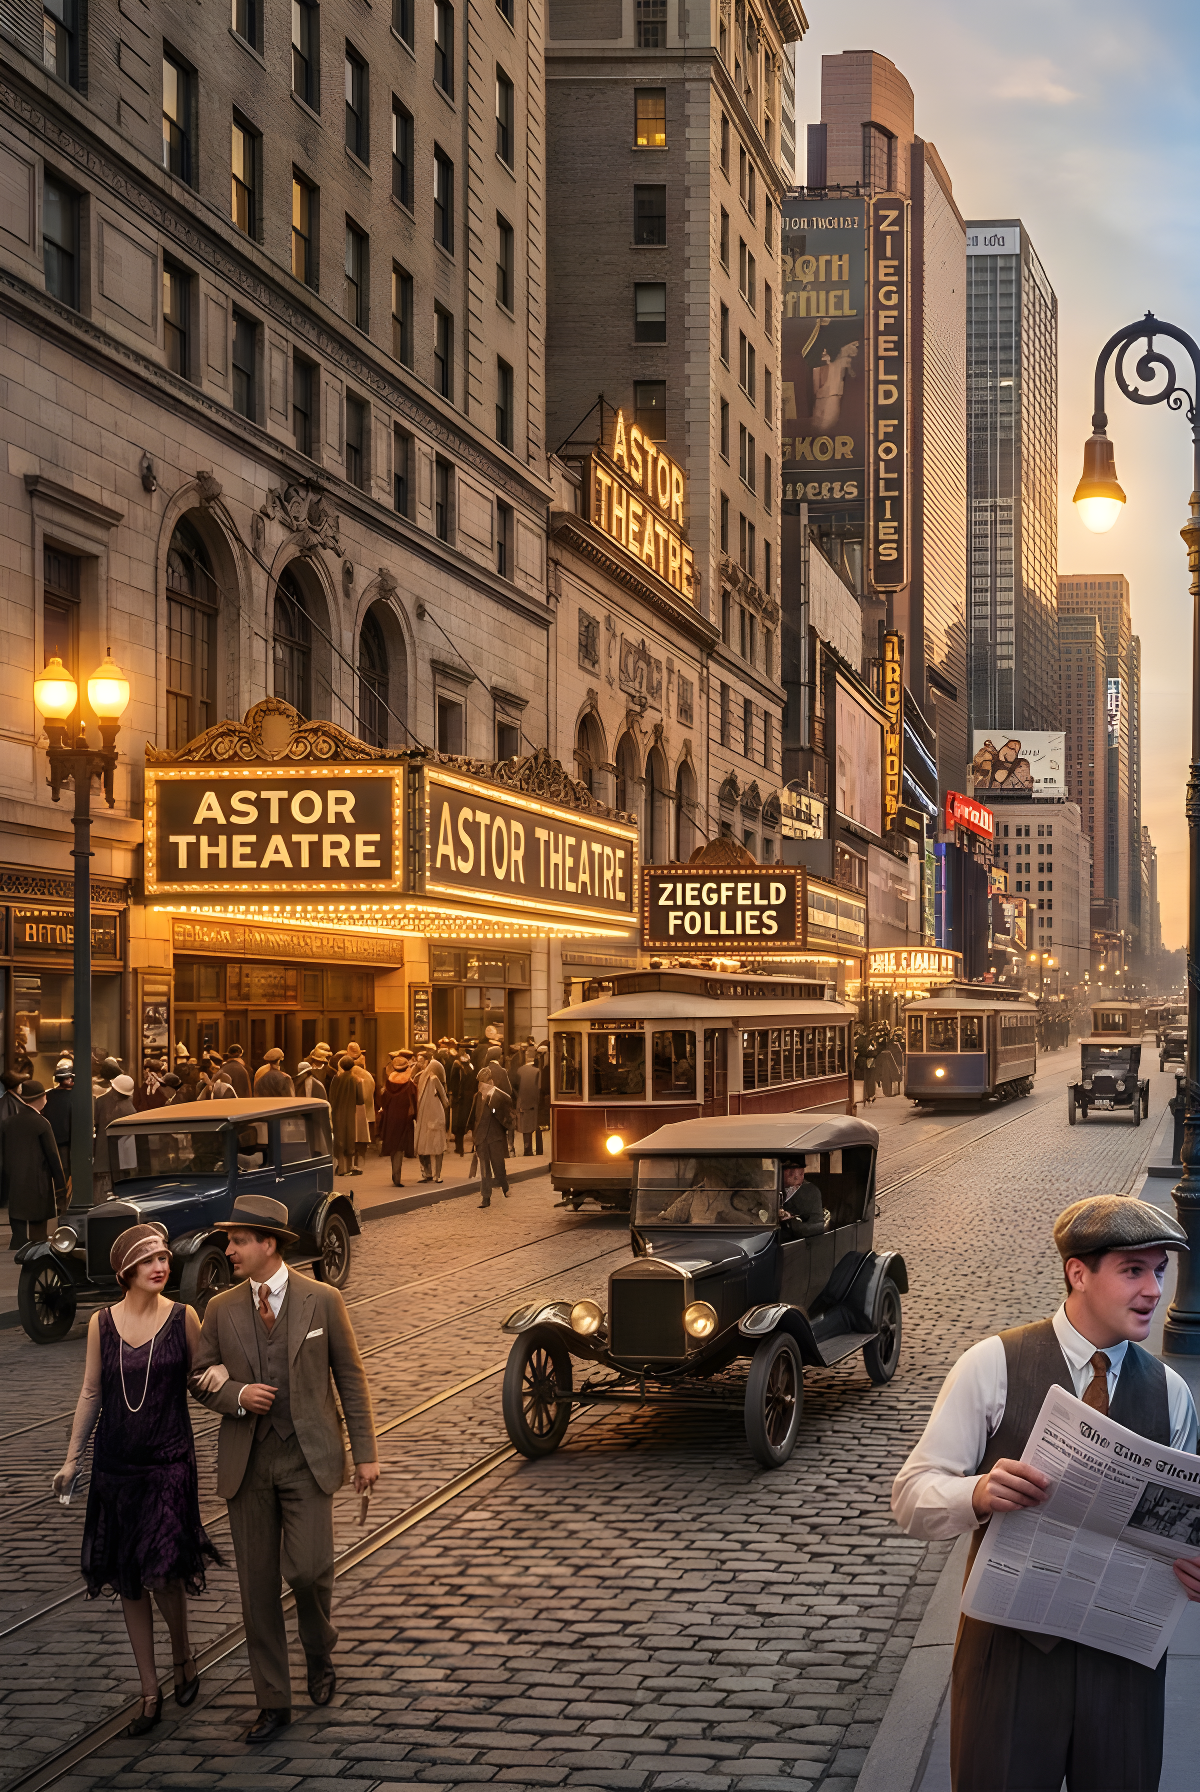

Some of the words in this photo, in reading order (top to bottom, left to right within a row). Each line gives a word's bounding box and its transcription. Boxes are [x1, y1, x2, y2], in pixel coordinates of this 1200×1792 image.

[877, 209, 900, 405] ZIEGFELD
[613, 408, 684, 527] ASTOR
[877, 419, 899, 561] FOLLIES
[596, 464, 694, 600] THEATRE
[168, 833, 381, 869] THEATRE
[192, 789, 356, 825] ASTOR
[435, 801, 526, 885] ASTOR
[534, 826, 626, 902] THEATRE
[657, 882, 787, 906] ZIEGFELD
[668, 910, 779, 936] FOLLIES
